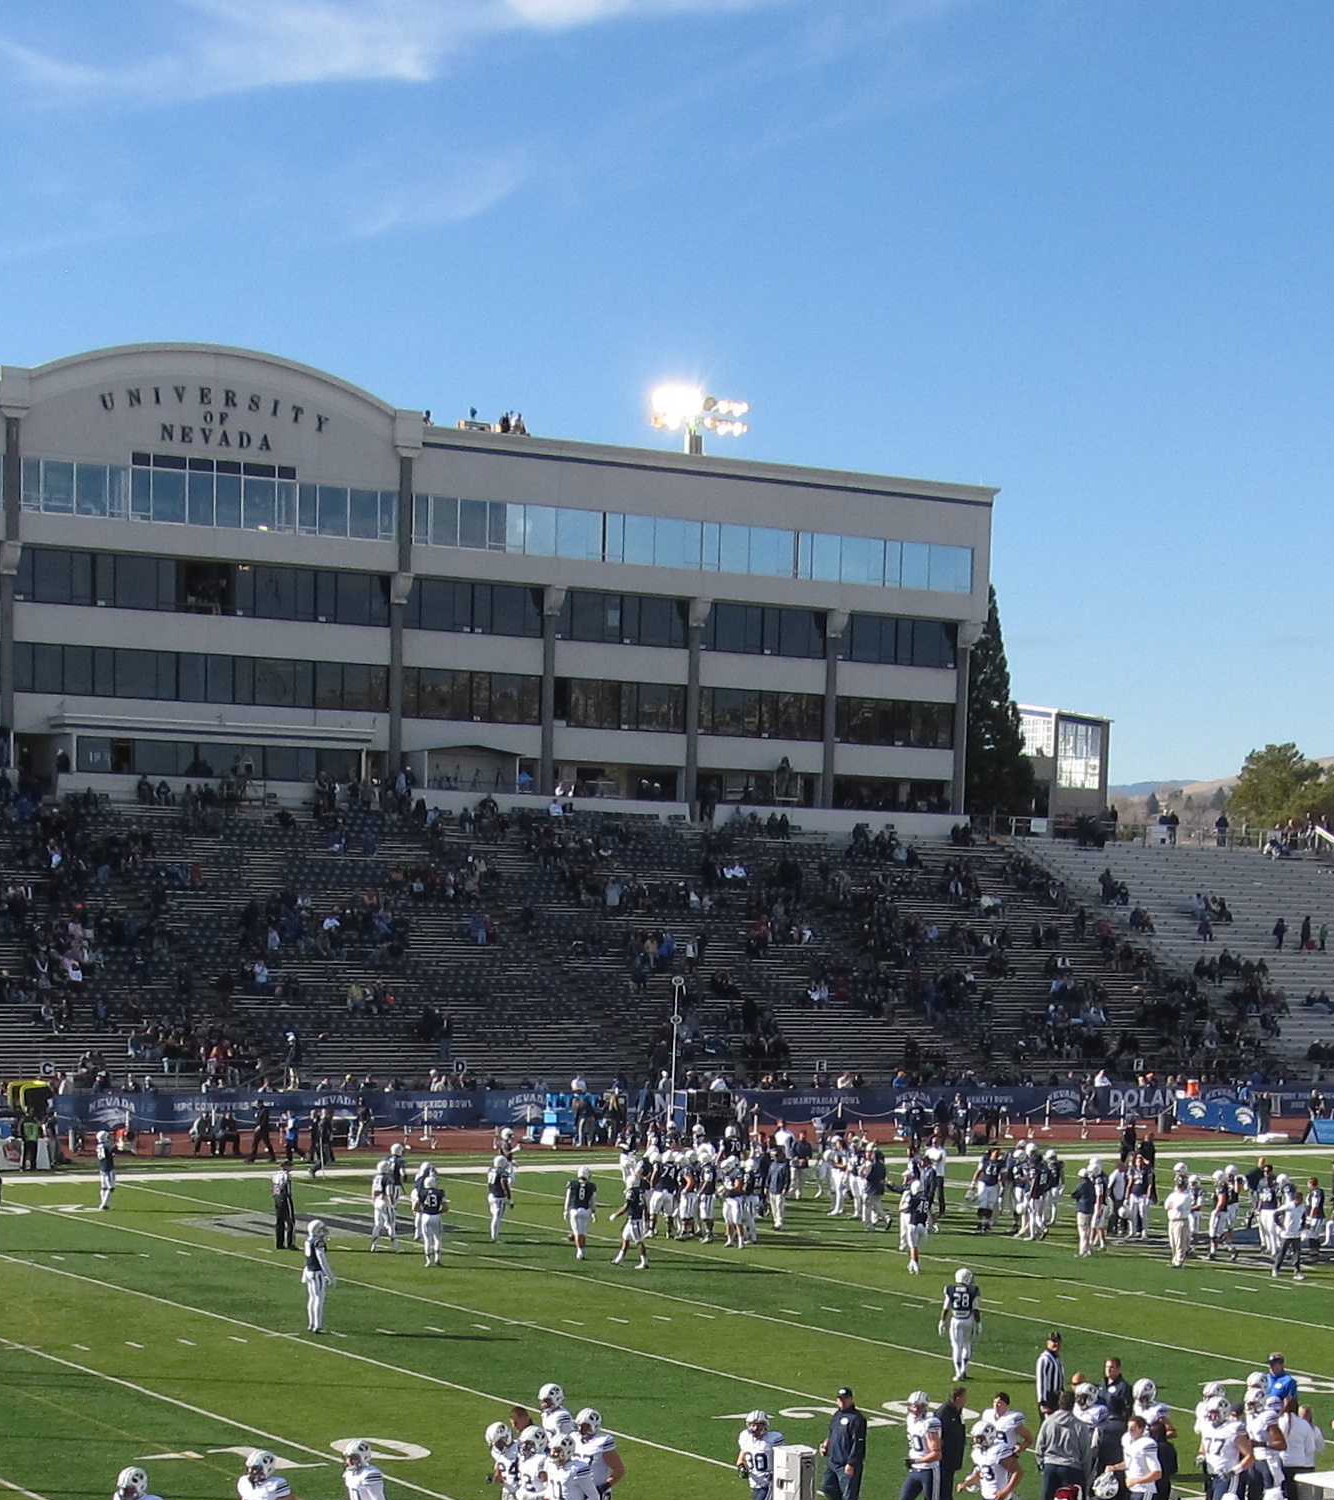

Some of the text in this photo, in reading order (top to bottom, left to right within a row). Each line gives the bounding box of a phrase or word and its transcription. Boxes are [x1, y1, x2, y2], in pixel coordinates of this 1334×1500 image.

[100, 386, 330, 433] UNIVERSITY
[203, 410, 229, 426] OF
[161, 423, 272, 451] NEVADA
[423, 1194, 438, 1208] 43
[953, 1293, 970, 1309] 28
[1205, 1436, 1226, 1456] 77
